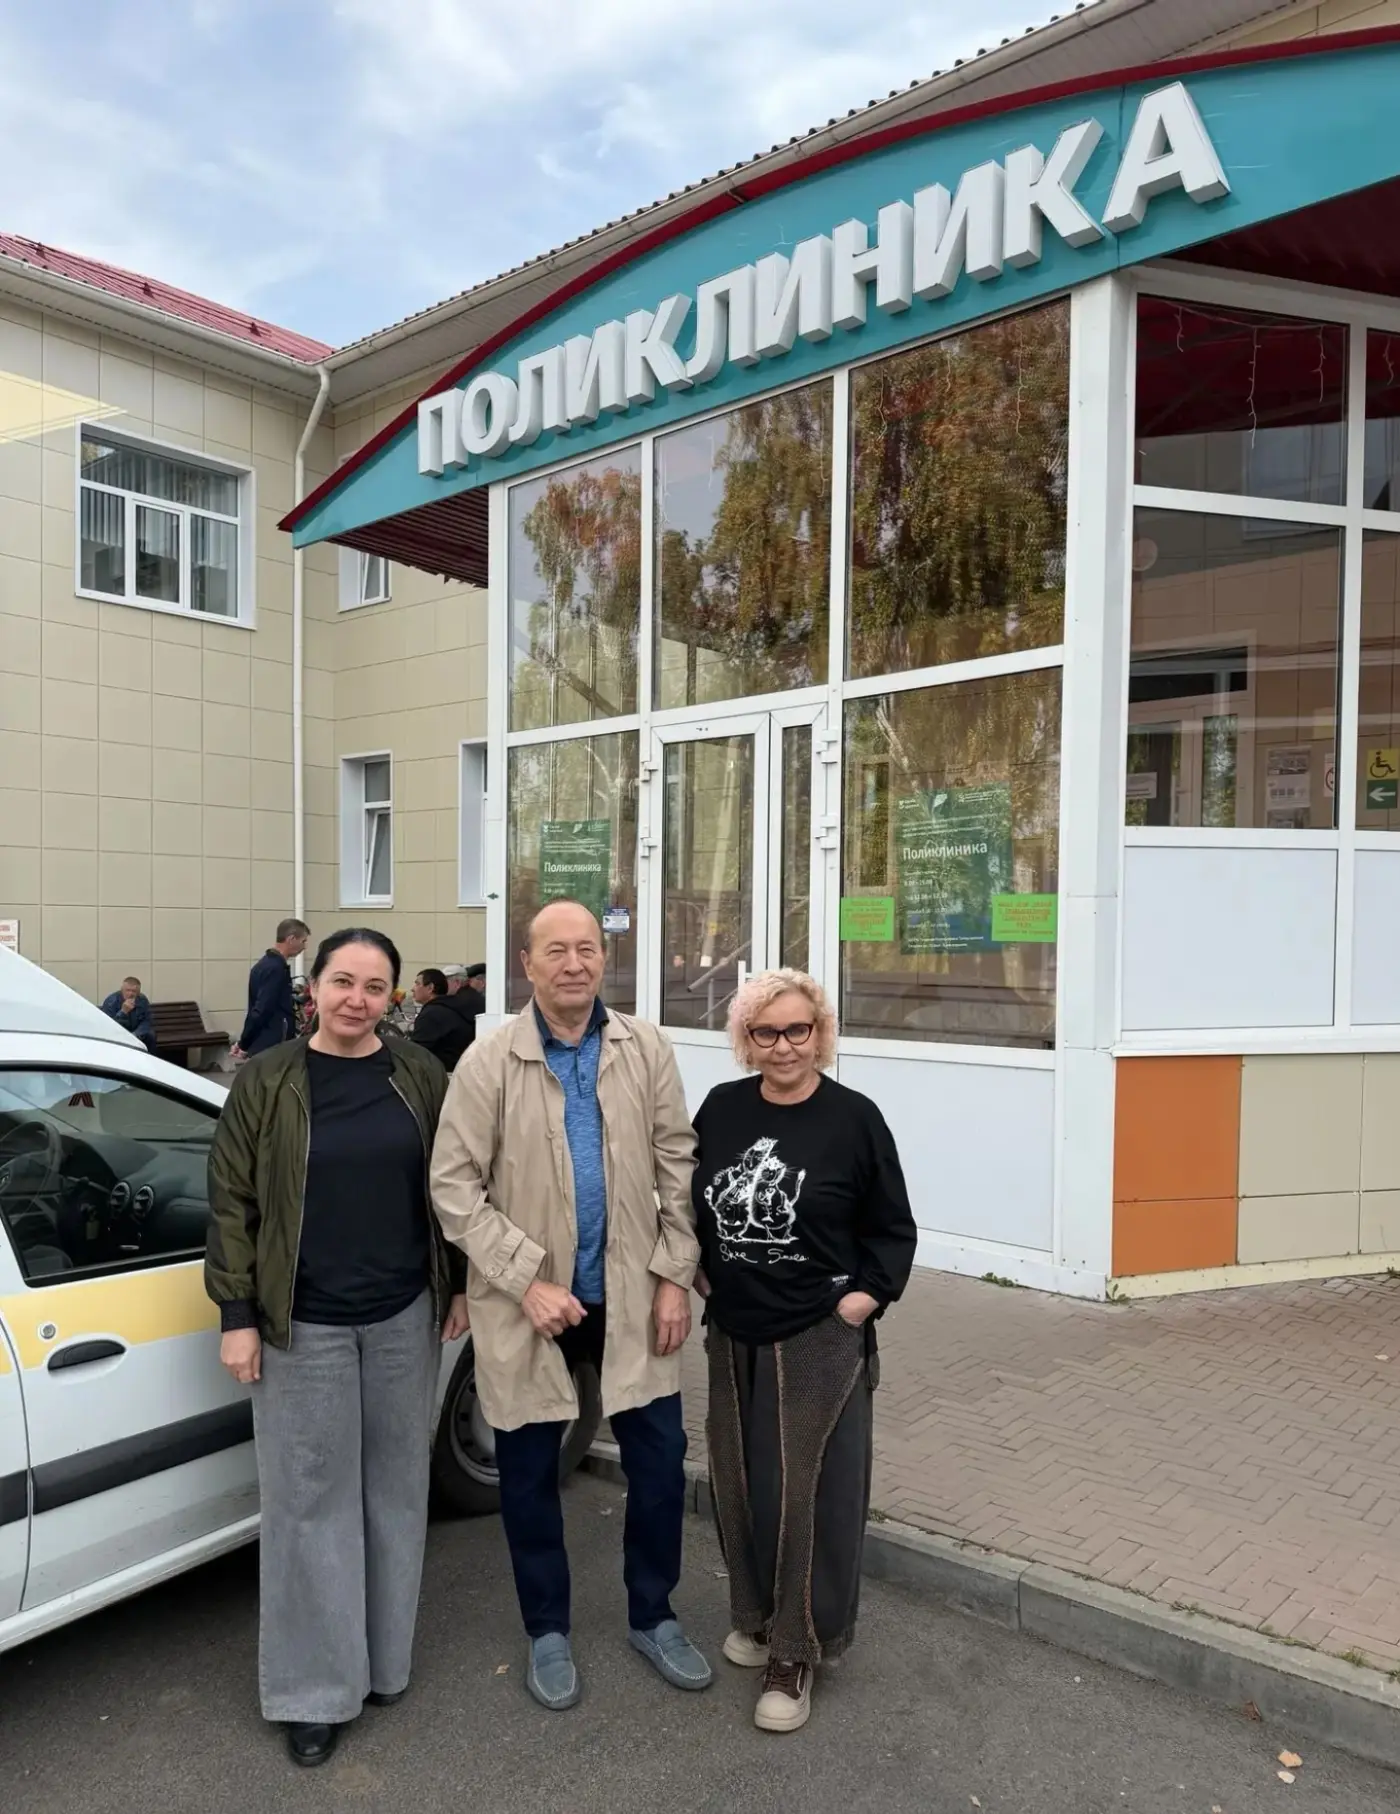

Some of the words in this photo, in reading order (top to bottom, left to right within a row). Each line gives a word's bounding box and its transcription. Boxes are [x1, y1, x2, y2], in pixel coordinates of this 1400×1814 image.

[418, 81, 1231, 477] ПОЛИКЛИНИКА
[903, 842, 988, 861] Поликлиника
[543, 861, 602, 873] Поликлиника
